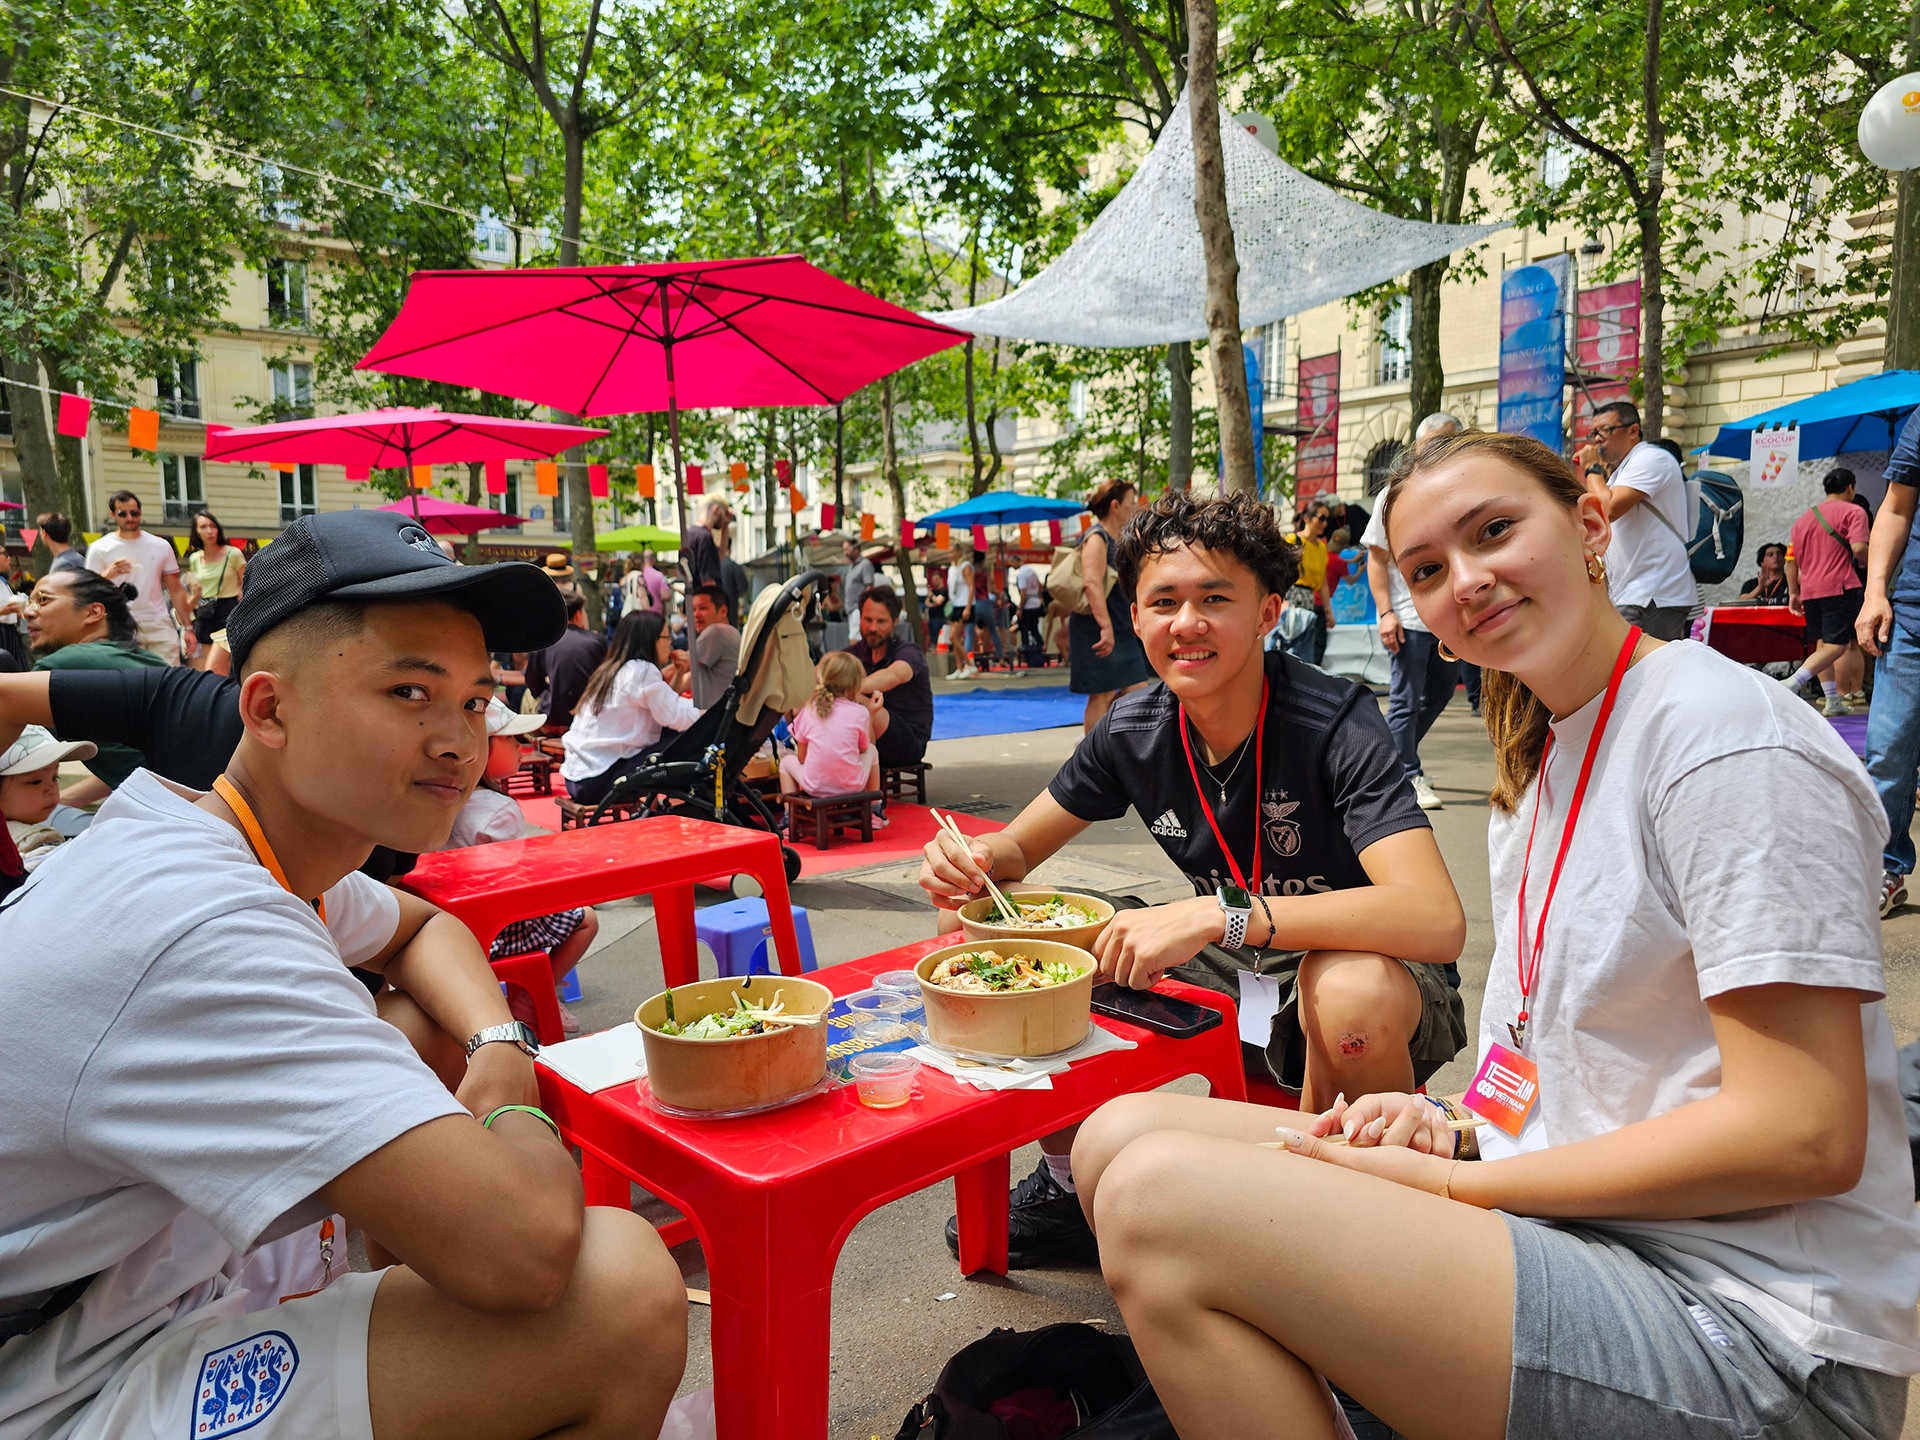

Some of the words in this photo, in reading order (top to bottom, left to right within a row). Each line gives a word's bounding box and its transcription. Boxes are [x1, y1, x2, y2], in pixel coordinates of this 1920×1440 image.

[1729, 400, 1788, 418] LIBERT
[1755, 436, 1795, 446] ECOCUP
[1150, 822, 1187, 838] adidas
[1484, 1060, 1536, 1102] TEAM
[1493, 1096, 1523, 1116] FESTIVAL
